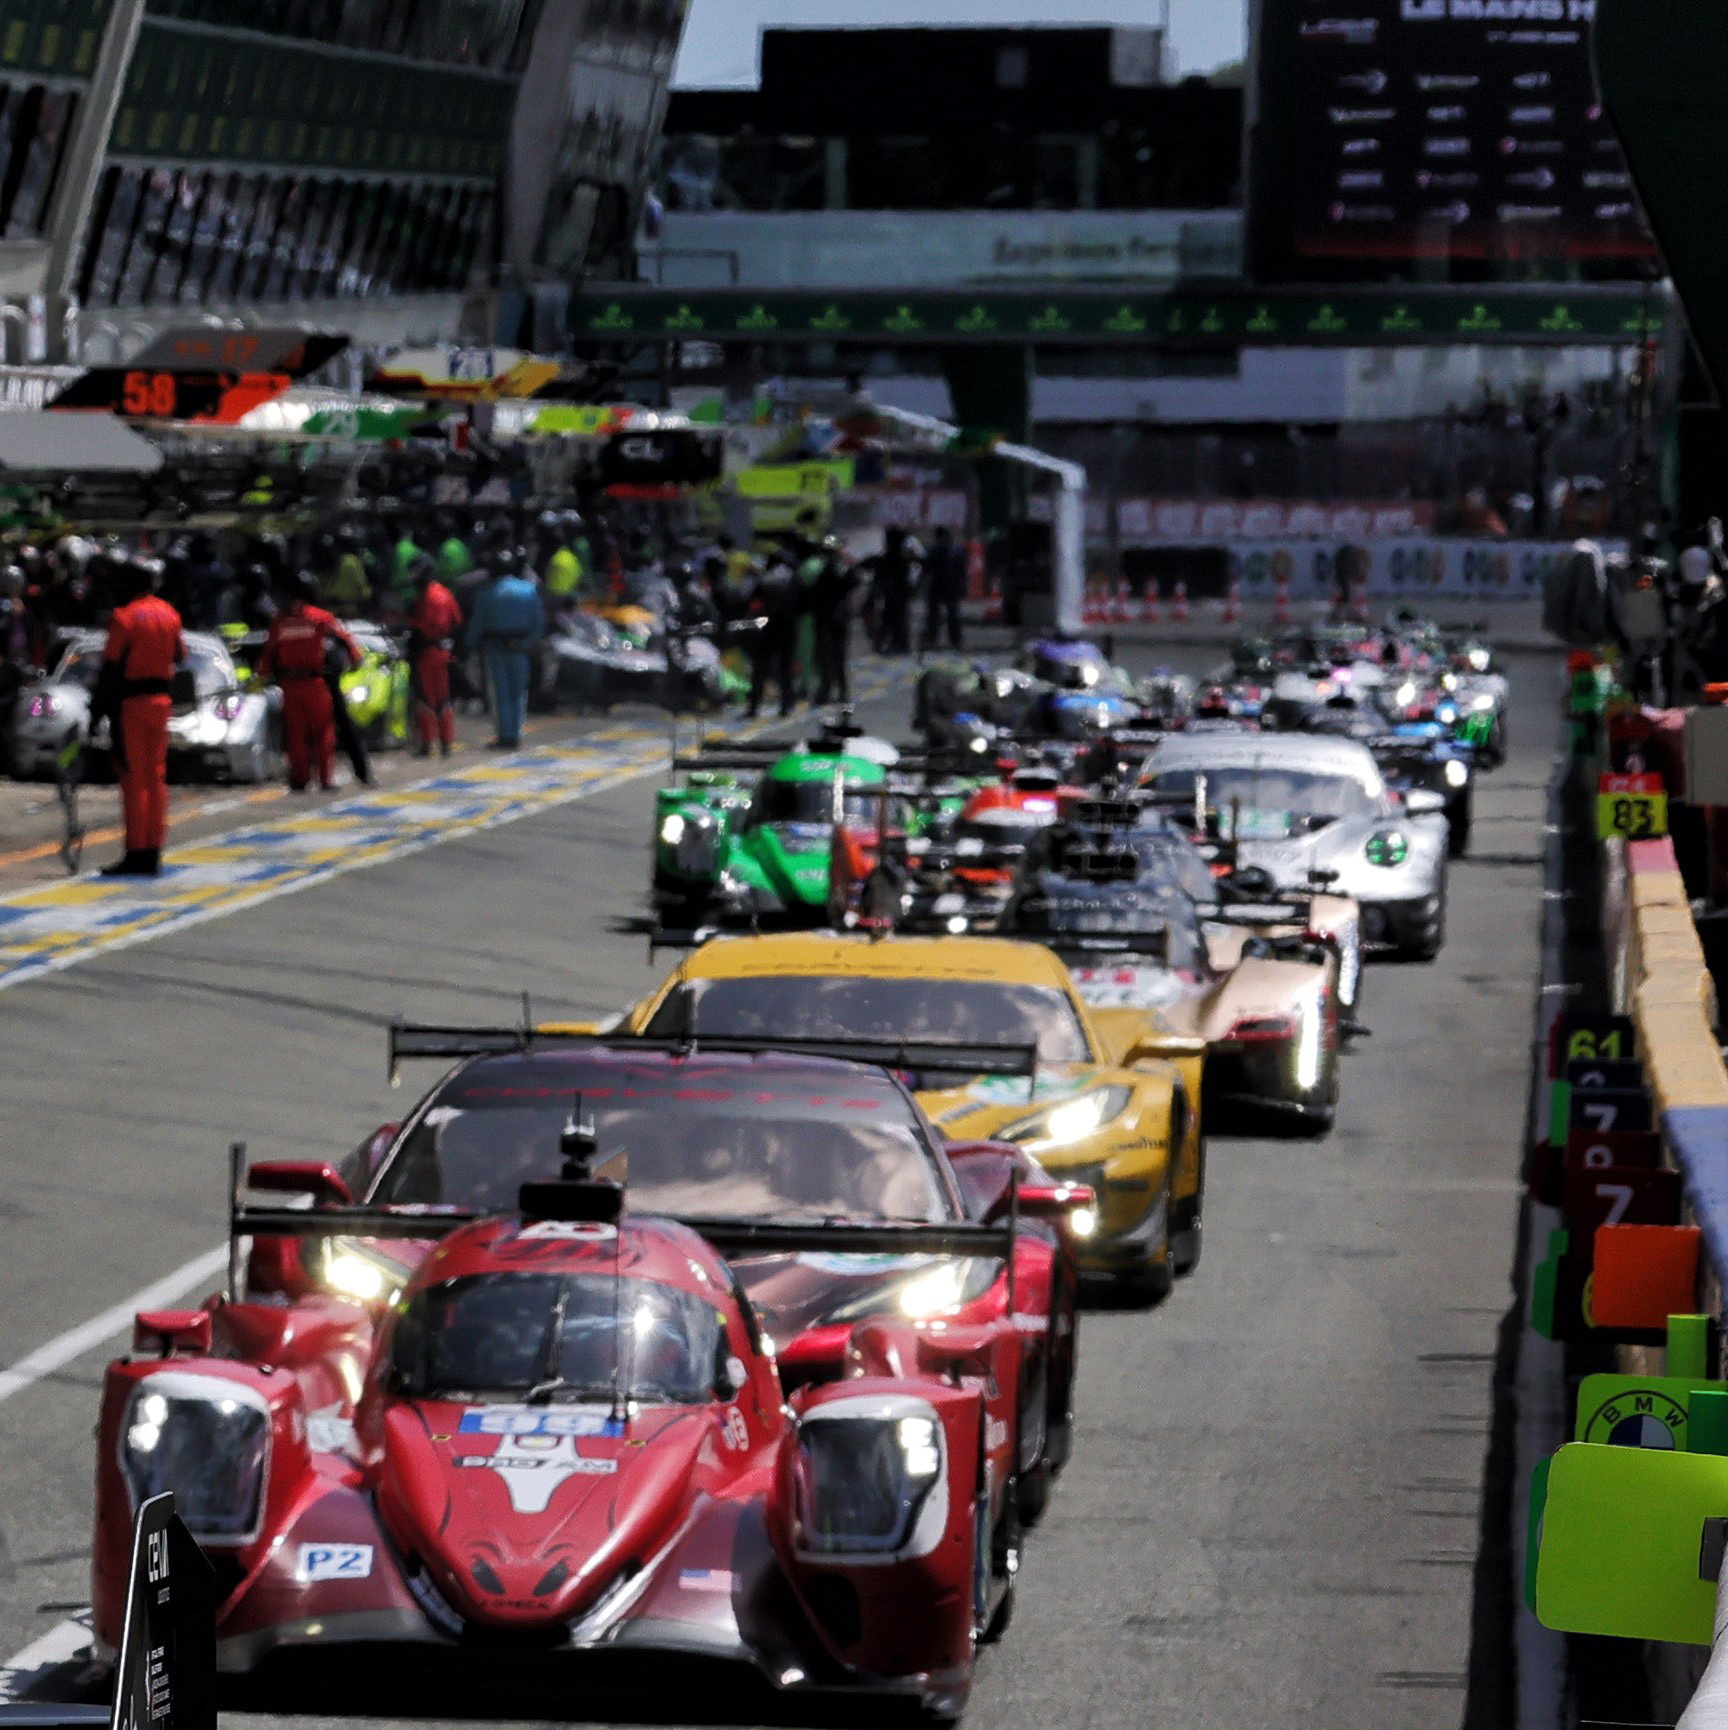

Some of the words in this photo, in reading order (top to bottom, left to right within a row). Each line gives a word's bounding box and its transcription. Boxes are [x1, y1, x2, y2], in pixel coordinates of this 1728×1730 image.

[123, 370, 175, 415] 58
[1602, 1396, 1685, 1429] BMW
[307, 1551, 362, 1573] P2
